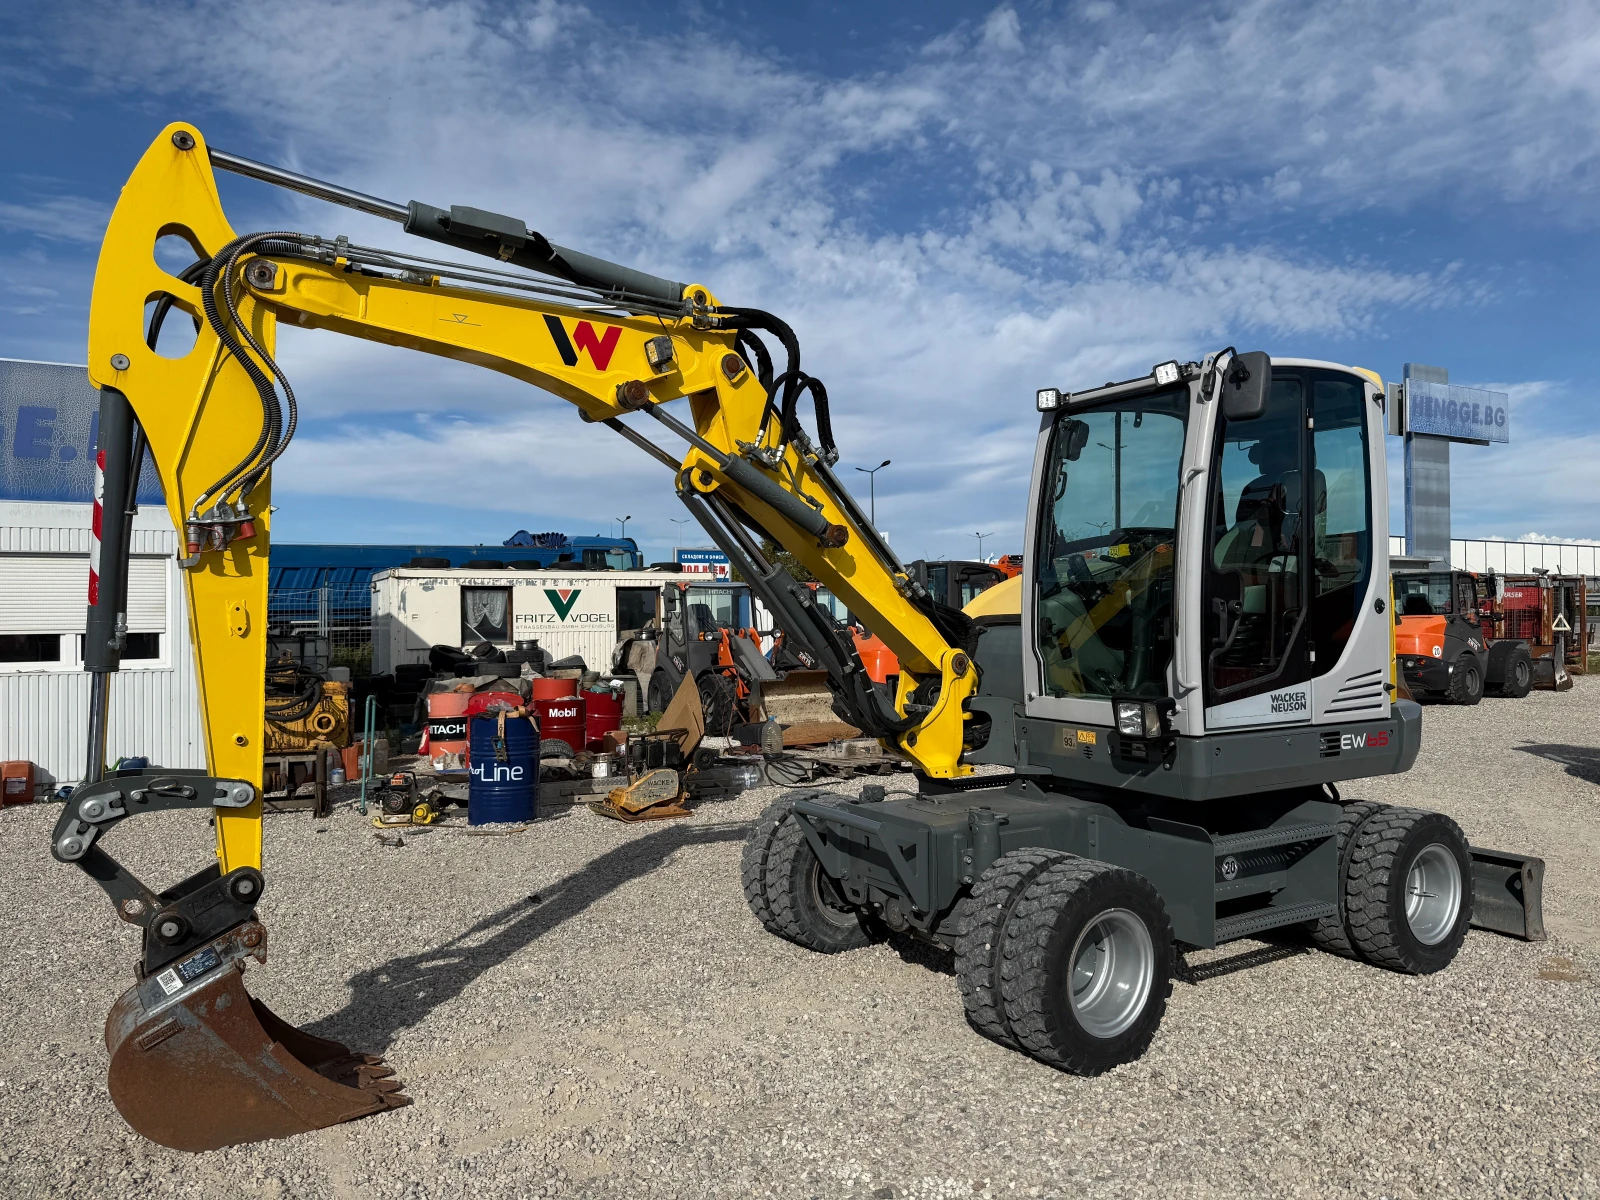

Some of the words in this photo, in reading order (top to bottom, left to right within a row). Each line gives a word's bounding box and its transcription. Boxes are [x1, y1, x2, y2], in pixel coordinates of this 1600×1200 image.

[1411, 394, 1506, 428] HENGGE.BG
[702, 565, 726, 574] НЕМ
[515, 613, 556, 624] FRITZ
[570, 613, 615, 623] VOGEL
[1270, 692, 1306, 704] WACKER
[548, 708, 576, 718] Mobil
[1271, 701, 1307, 713] NEUSON
[1341, 731, 1389, 750] EW65
[1225, 860, 1236, 875] 20
